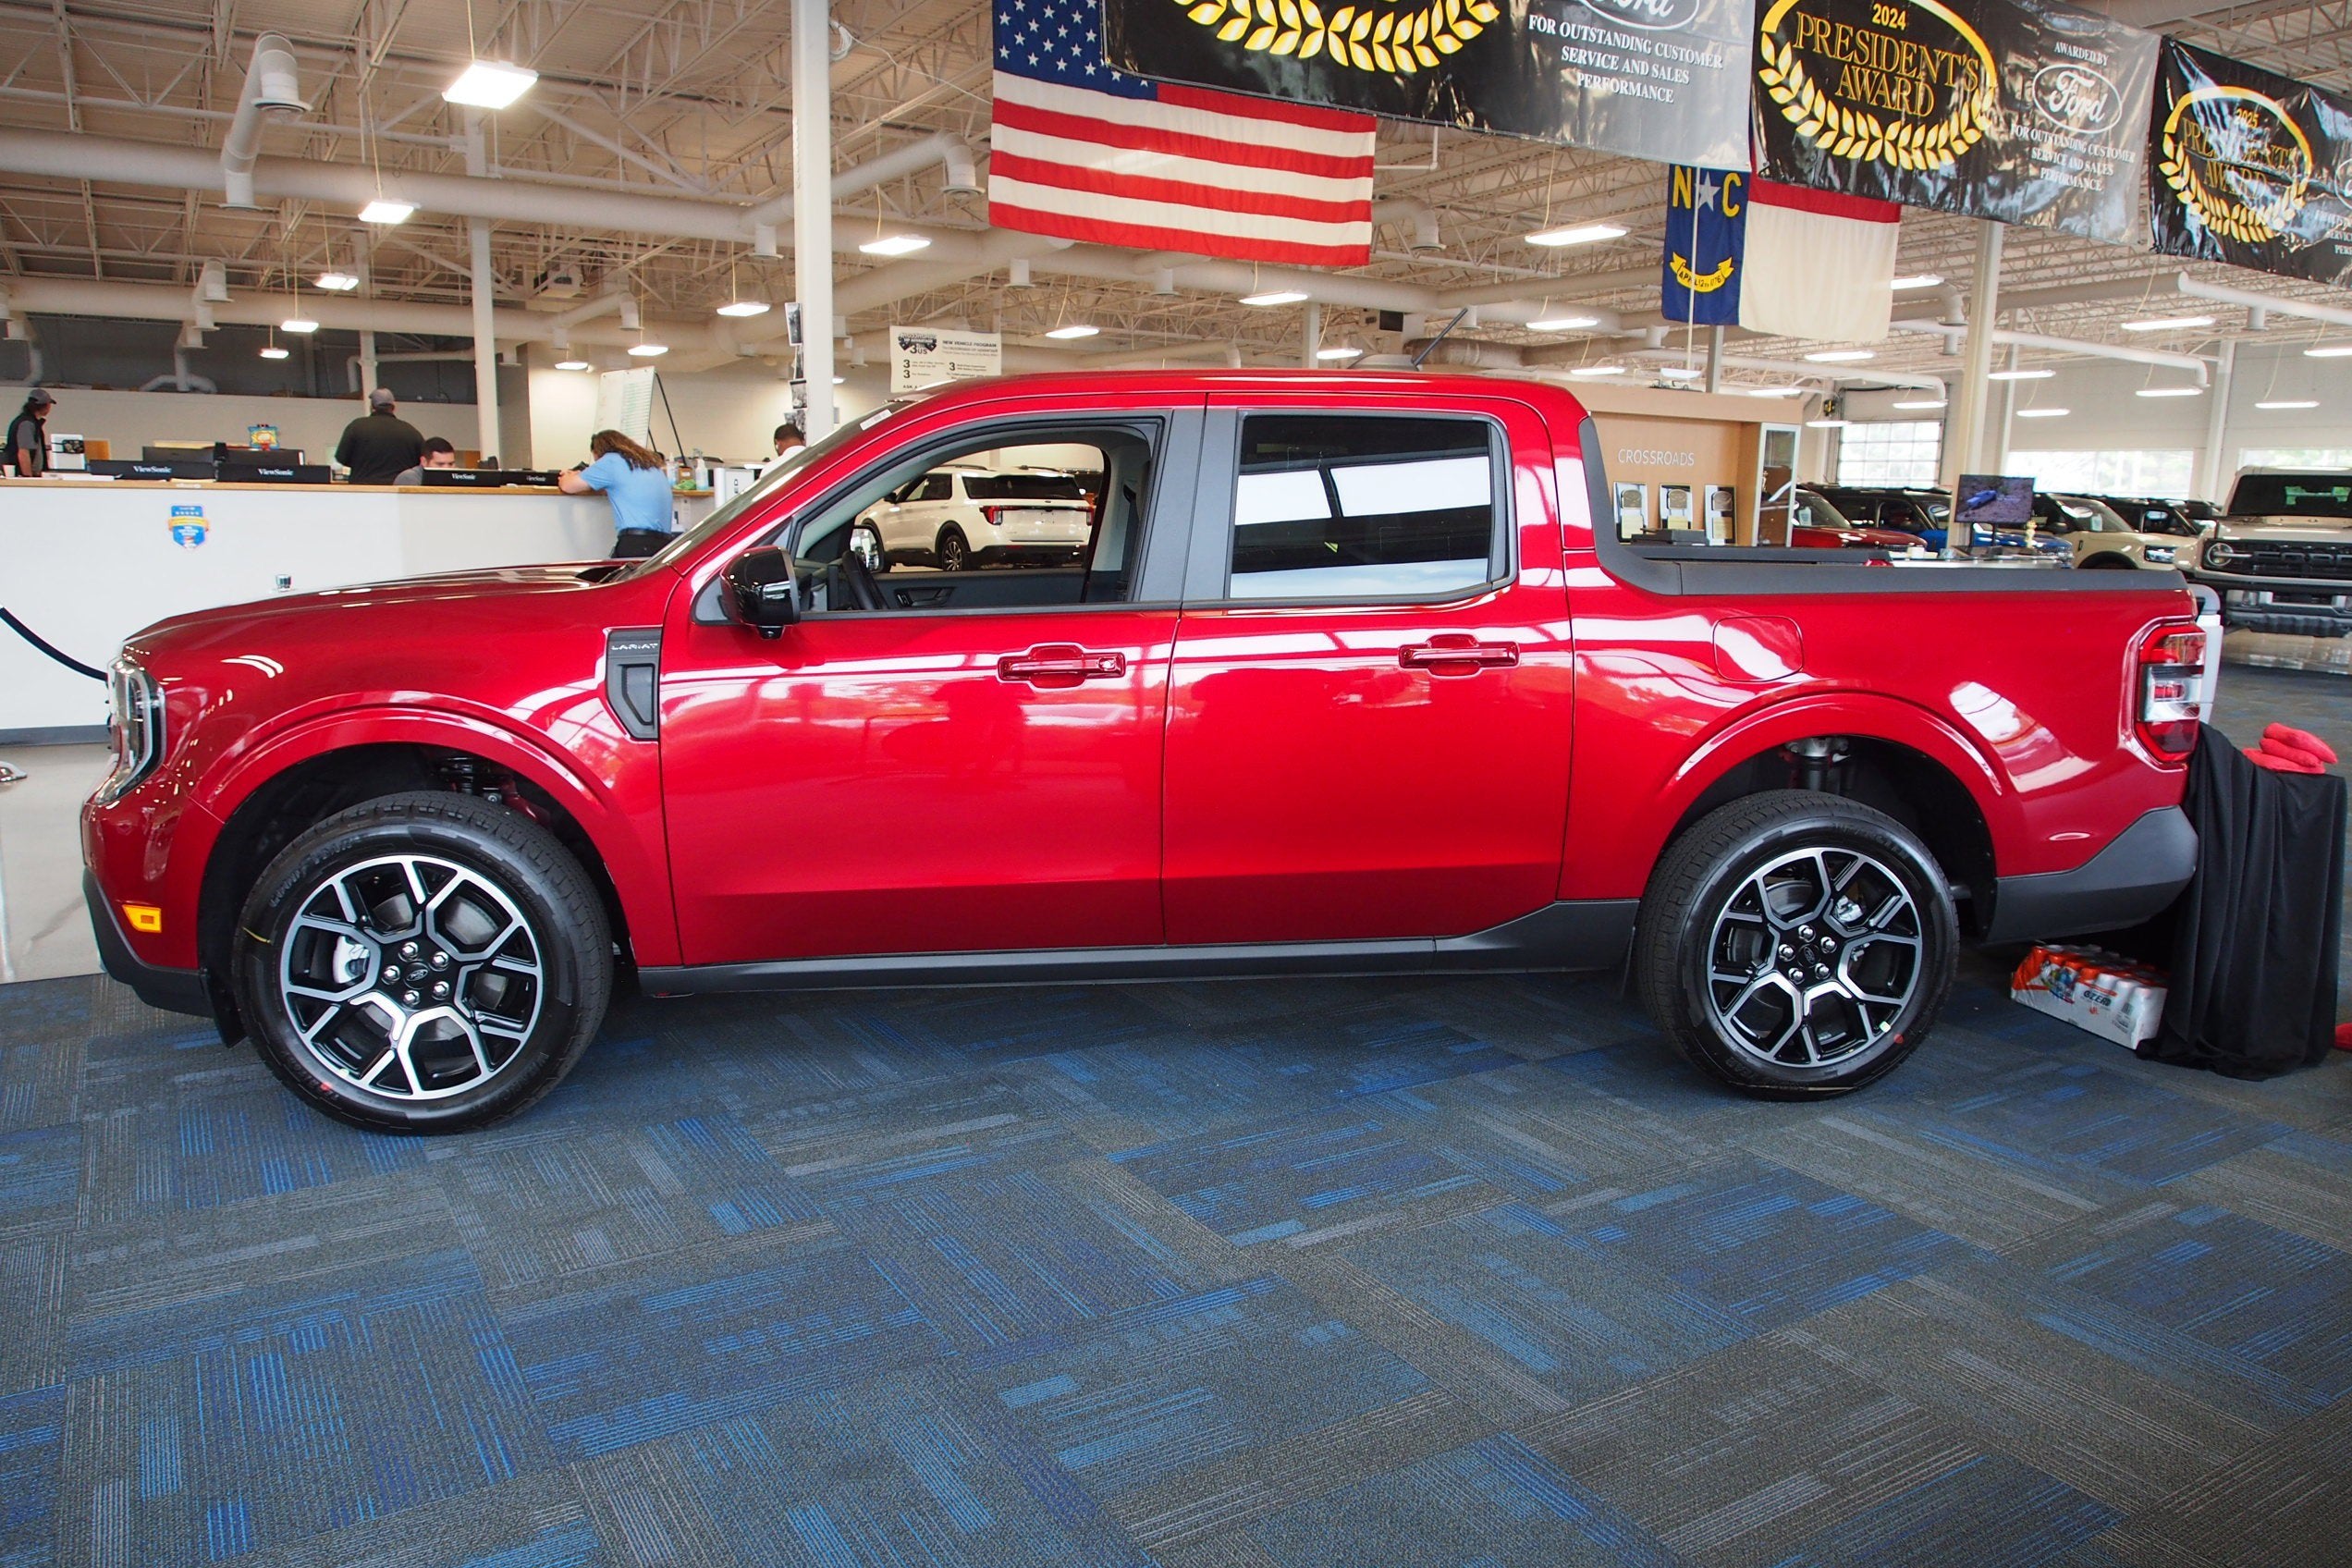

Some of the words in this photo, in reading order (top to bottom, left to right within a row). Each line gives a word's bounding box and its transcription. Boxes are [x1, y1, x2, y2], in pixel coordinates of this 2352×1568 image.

[1871, 3, 1907, 31] 2024
[1528, 14, 1557, 35] FOR
[1559, 21, 1652, 55] OUTSTANDING
[1655, 43, 1724, 69] CUSTOMER
[1793, 11, 1980, 92] PRESIDENT'S
[1561, 45, 1620, 71] SERVICE
[1621, 58, 1649, 77] AND
[1650, 65, 1691, 85] SALES
[2053, 42, 2097, 64] AWARDED
[2097, 53, 2110, 67] BY
[1576, 73, 1675, 104] PERFORMANCE
[1835, 64, 1935, 117] AWARD
[2049, 70, 2109, 124] Ford
[2236, 107, 2261, 129] 2025
[2010, 124, 2030, 139] FOR
[2029, 129, 2088, 155] OUTSTANDING
[2088, 142, 2137, 164] CUSTOMER
[2031, 146, 2067, 166] SERVICE
[2068, 157, 2084, 170] AND
[2084, 160, 2114, 177] SALES
[1672, 165, 1693, 210] N
[1721, 172, 1743, 218] C
[2040, 167, 2103, 192] PERFORMANCE
[903, 359, 911, 369] 3
[903, 369, 911, 379] 3
[949, 361, 956, 372] 3
[133, 465, 173, 474] ViewSonic
[1618, 448, 1695, 466] CROSSROADS
[257, 468, 294, 476] ViewSonic
[451, 472, 477, 481] ViewSonic
[610, 643, 658, 651] LARIAT
